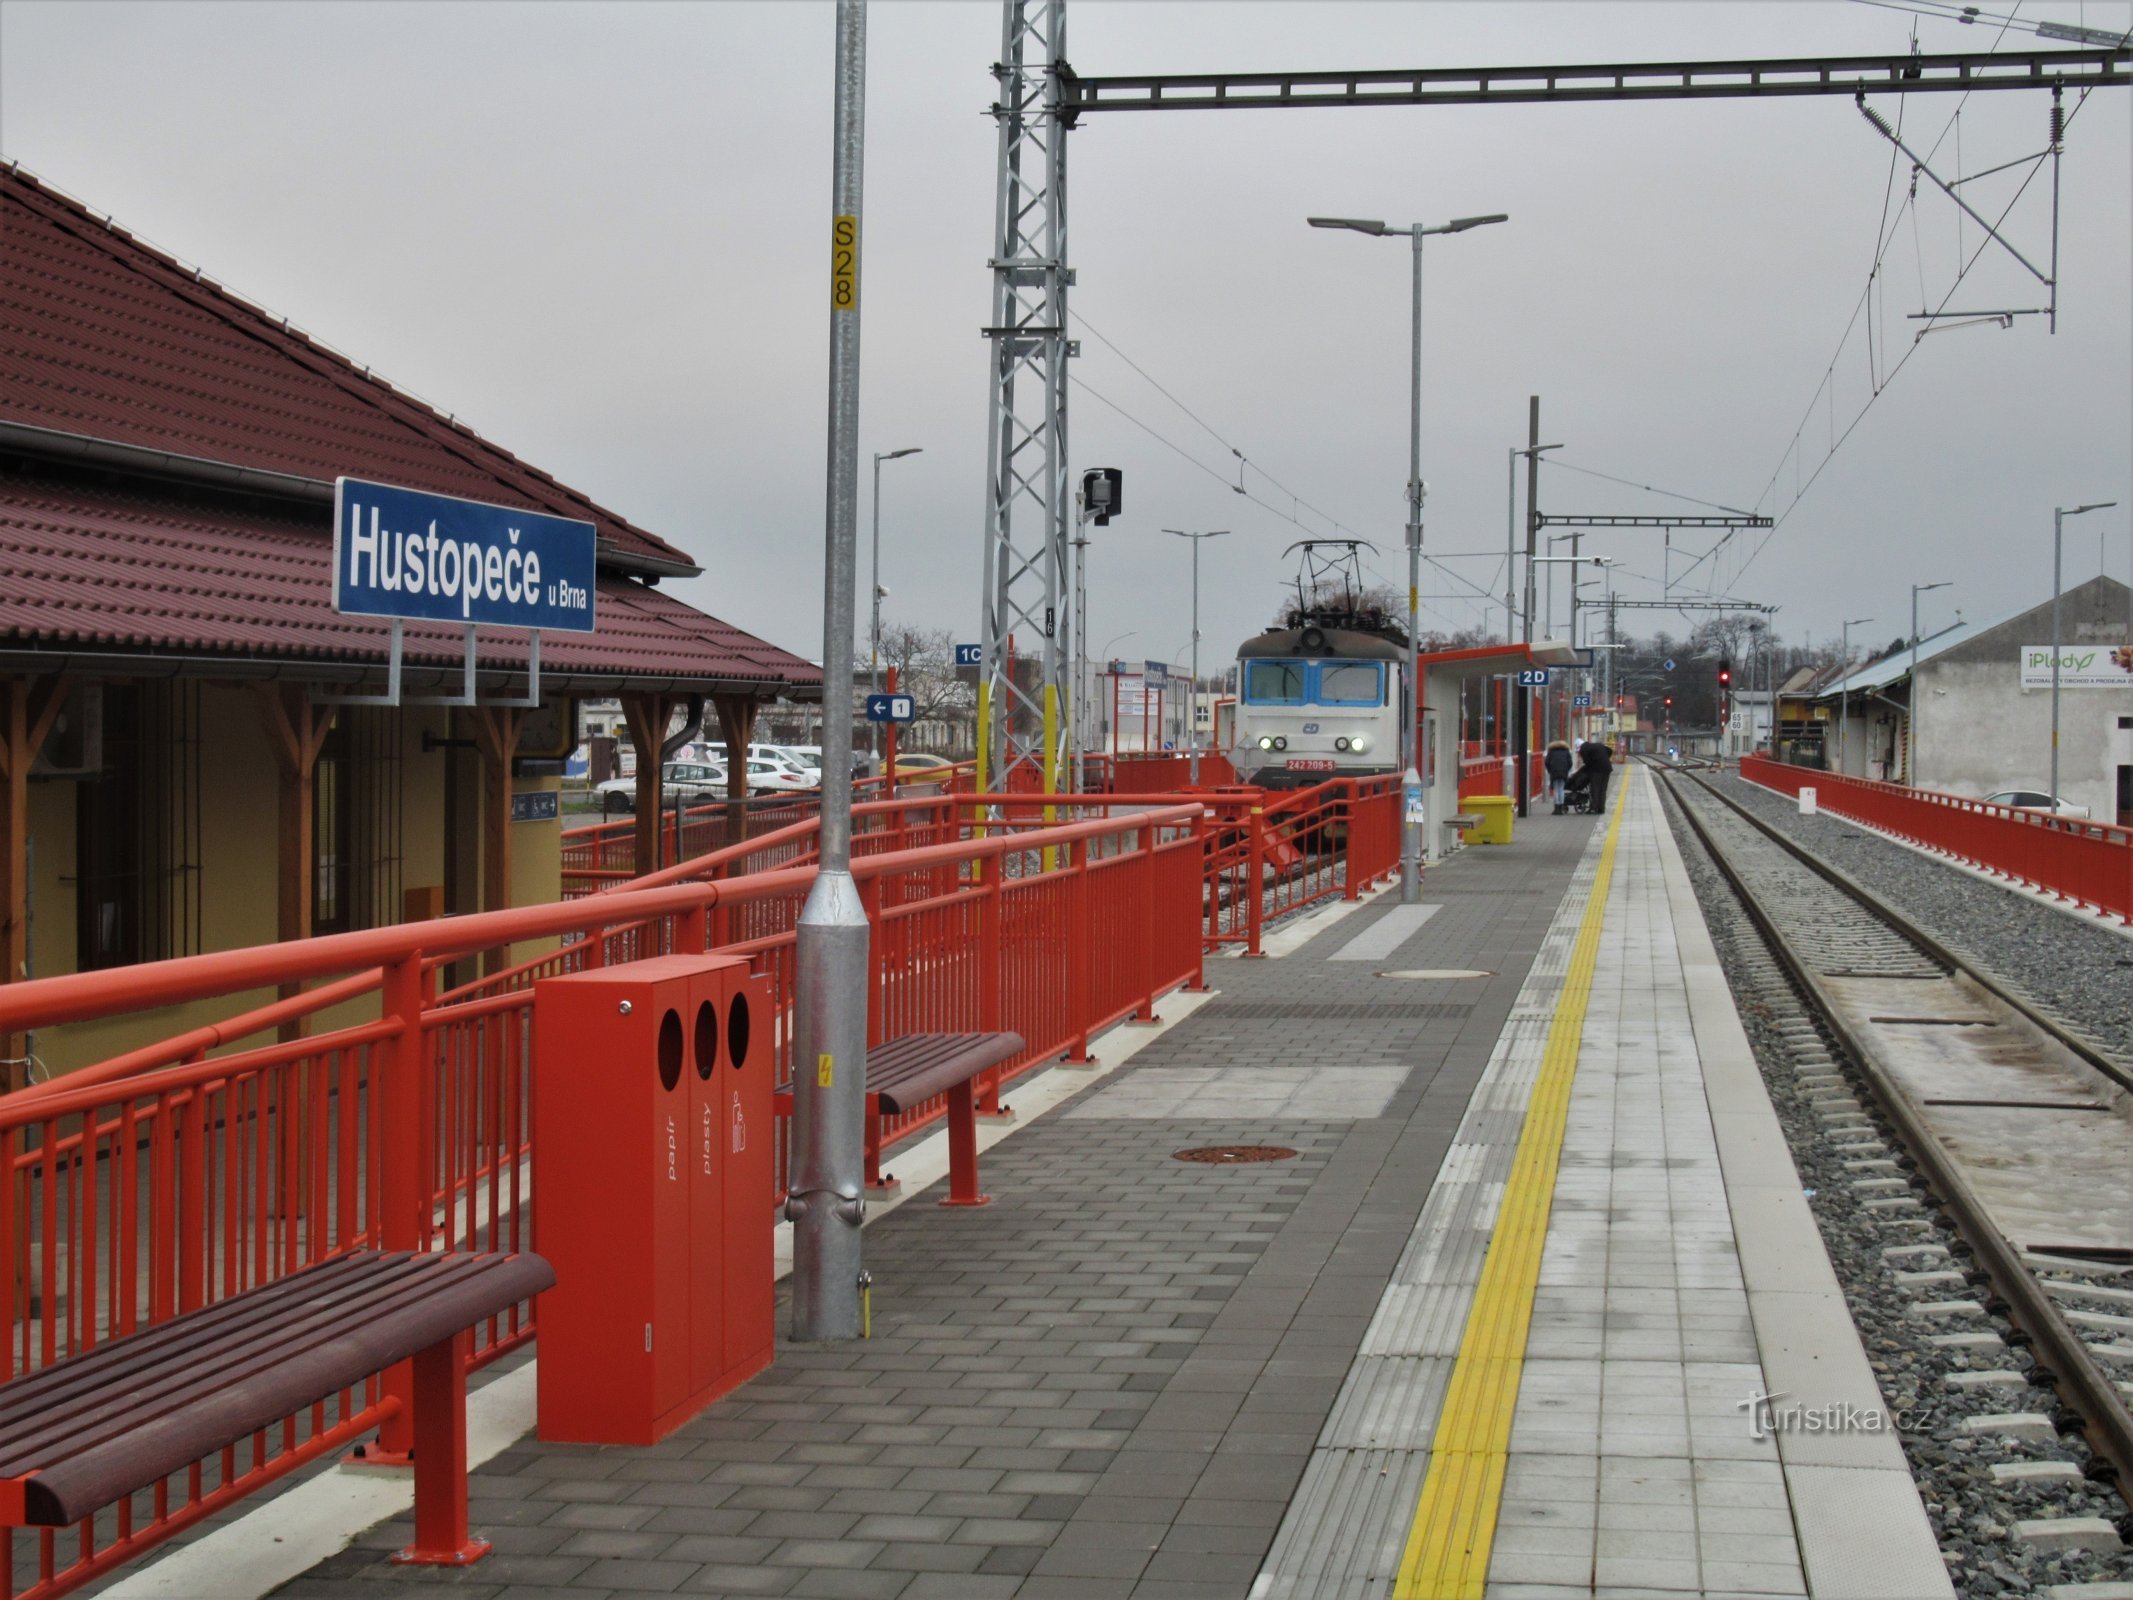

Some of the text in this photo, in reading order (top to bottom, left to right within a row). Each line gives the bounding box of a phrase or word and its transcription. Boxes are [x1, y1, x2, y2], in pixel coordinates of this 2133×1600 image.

[835, 220, 854, 305] S28
[350, 503, 587, 618] Hustopeče u Brna
[1047, 610, 1053, 634] 16
[961, 647, 981, 662] 1C
[1523, 671, 1545, 682] 2D
[898, 703, 903, 713] 1
[1288, 760, 1333, 770] 242 209-5
[666, 1115, 677, 1181] papír
[703, 1102, 711, 1176] plasty
